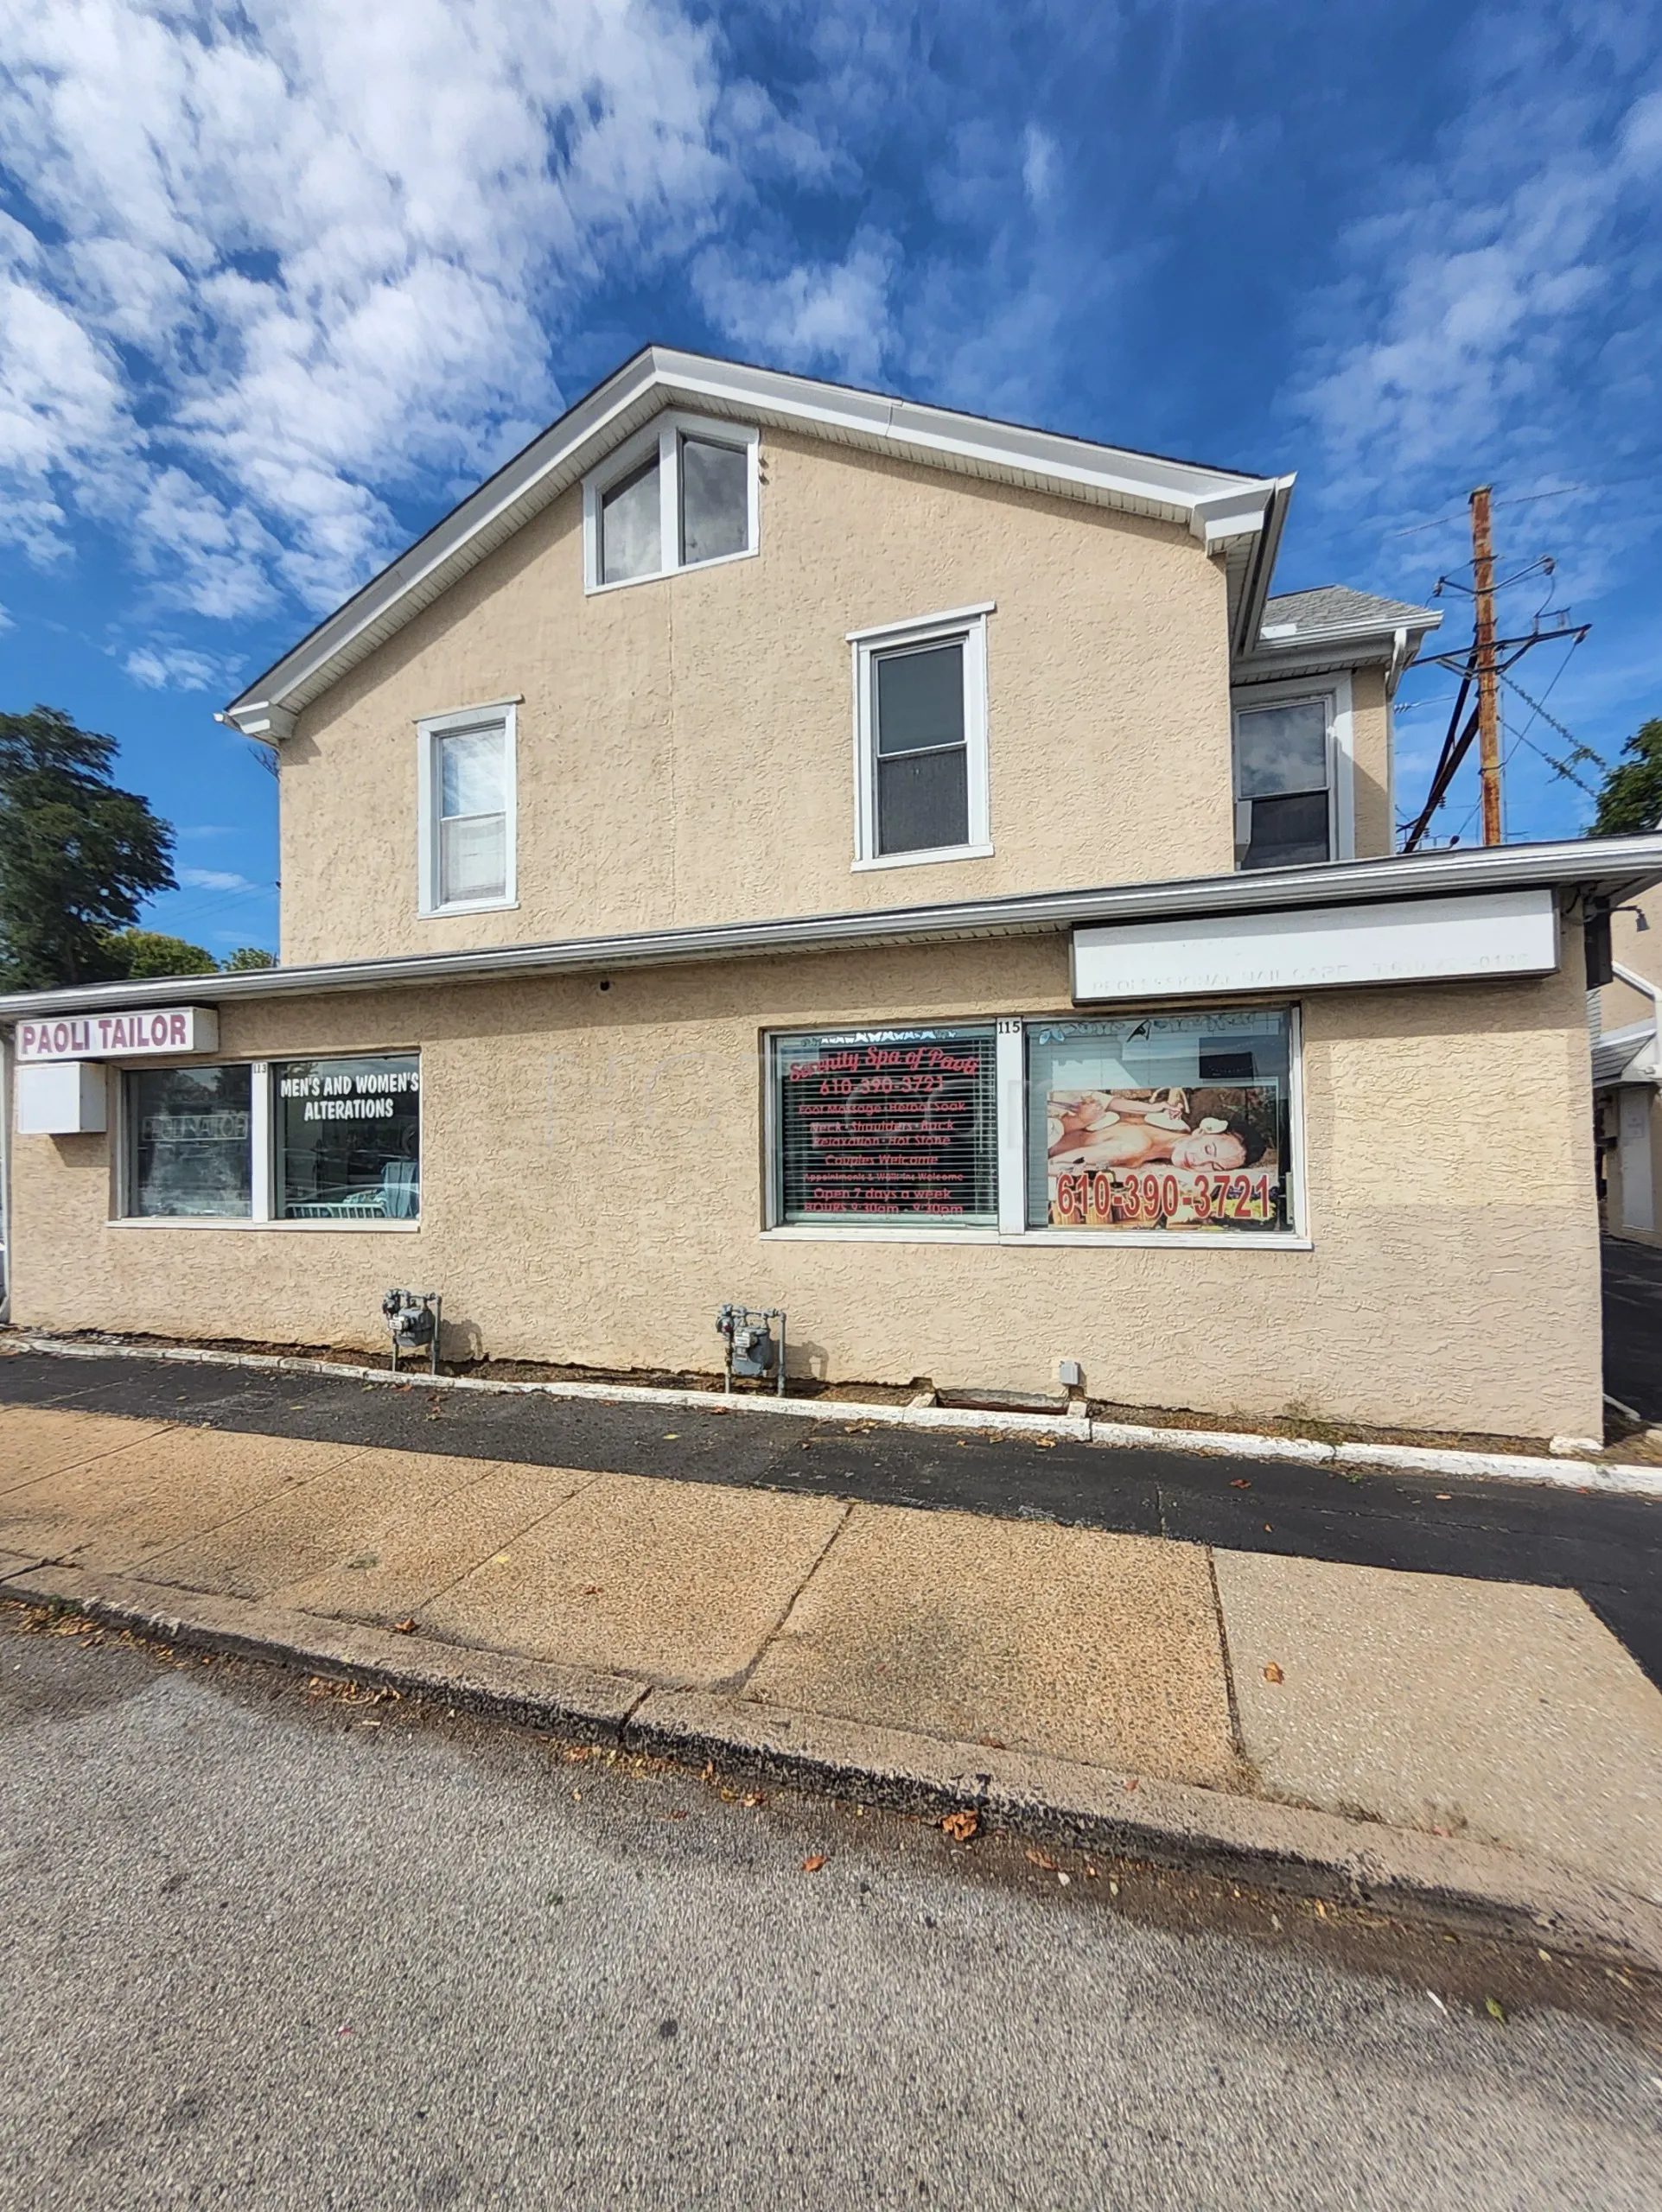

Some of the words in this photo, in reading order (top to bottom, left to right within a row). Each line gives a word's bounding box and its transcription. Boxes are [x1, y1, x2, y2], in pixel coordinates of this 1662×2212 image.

[21, 1020, 90, 1054] PAOLI
[99, 1014, 187, 1049] TAILOR
[997, 1021, 1020, 1034] 115
[253, 1064, 267, 1074] 113
[789, 1052, 860, 1081] Serenity
[865, 1046, 901, 1071] Spa
[906, 1047, 928, 1071] of
[280, 1077, 321, 1097] MEN'S
[323, 1075, 353, 1096] AND
[355, 1071, 420, 1094] WOMEN'S
[819, 1076, 944, 1096] 610-390-3721
[303, 1098, 394, 1122] ALTERATIONS
[827, 1104, 882, 1116] Massage
[935, 1102, 965, 1112] Soak
[810, 1122, 842, 1132] Neck
[851, 1120, 912, 1132] Shoulders
[920, 1120, 954, 1131] Back
[812, 1136, 879, 1146] Relaxation
[825, 1154, 875, 1167] Couples
[879, 1154, 938, 1165] Welcome
[918, 1173, 964, 1181] Welcome
[814, 1187, 850, 1201] Open
[854, 1188, 862, 1199] 7
[865, 1188, 897, 1202] days
[901, 1191, 909, 1199] a
[913, 1188, 952, 1199] week
[1056, 1173, 1270, 1218] 610-390-3721
[804, 1202, 847, 1212] HOURS
